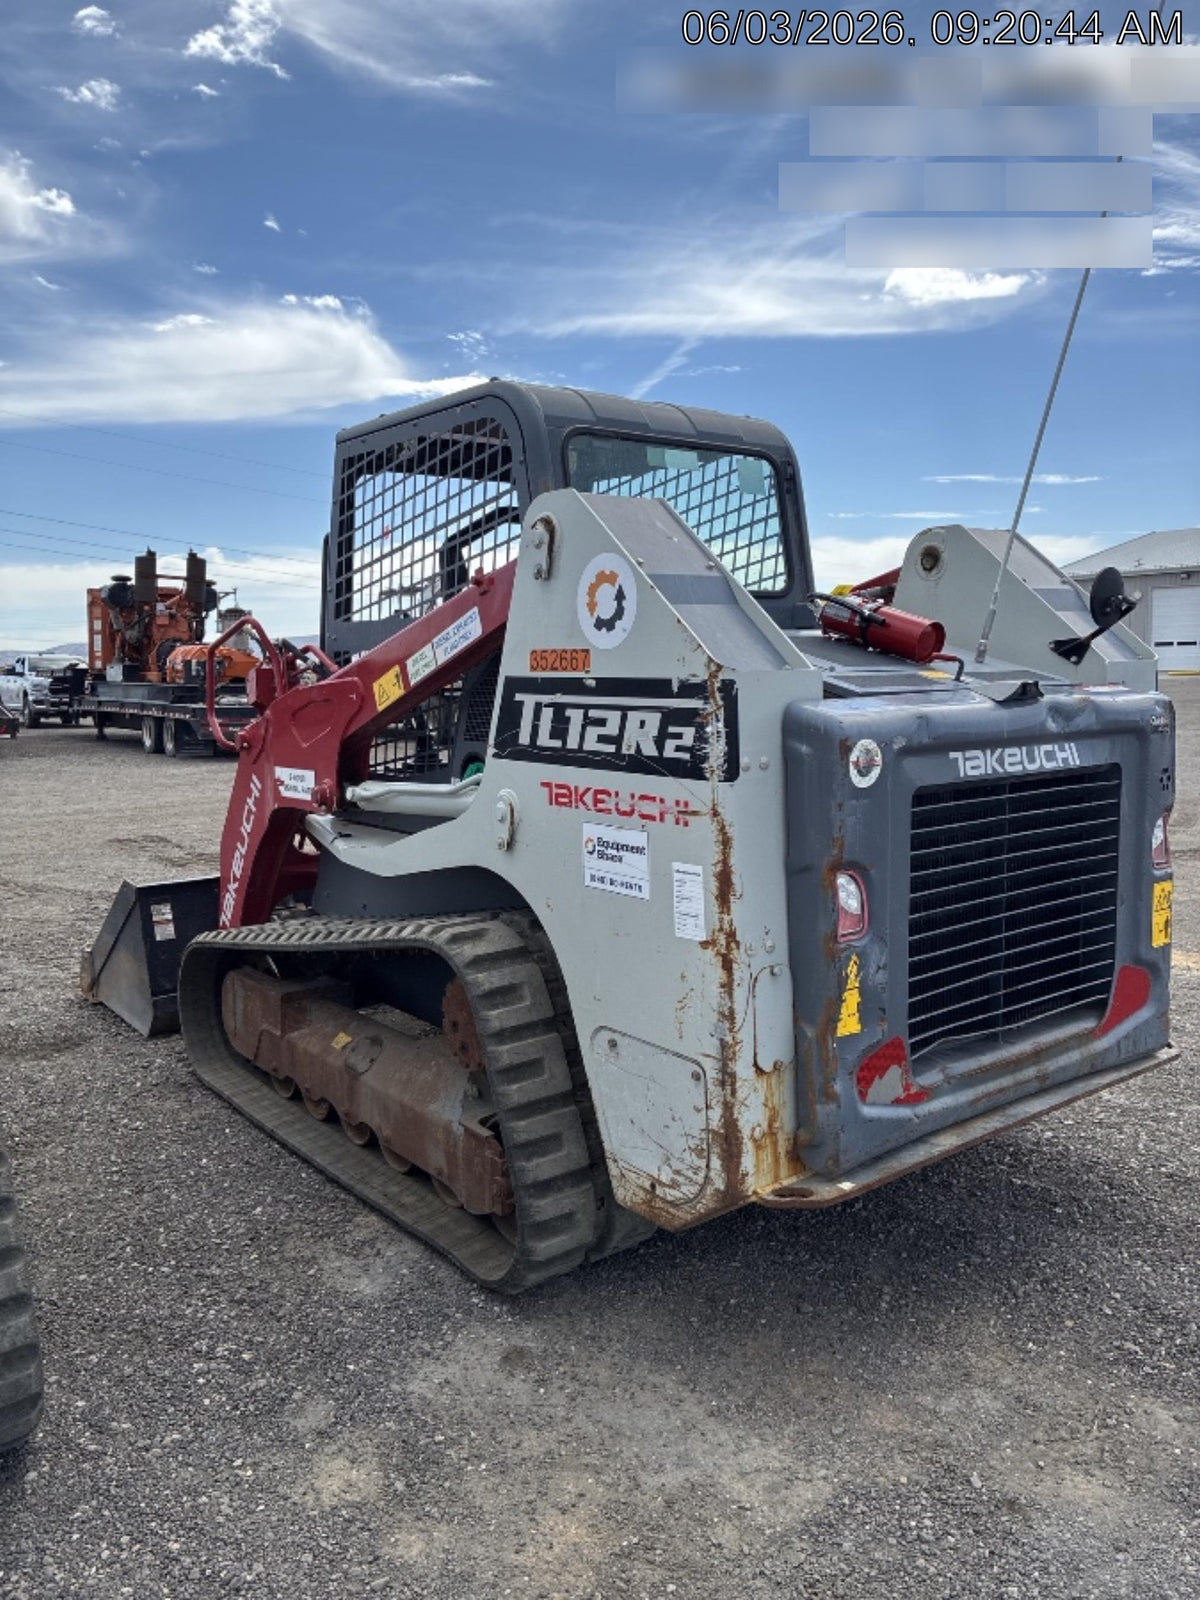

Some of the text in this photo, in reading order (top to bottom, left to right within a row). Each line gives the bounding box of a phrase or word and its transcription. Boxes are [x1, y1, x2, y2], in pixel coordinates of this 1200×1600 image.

[530, 648, 590, 671] 352667
[948, 742, 1081, 778] TAKEUCHI
[219, 773, 262, 928] TAKEUCHI
[597, 836, 647, 857] Equipment
